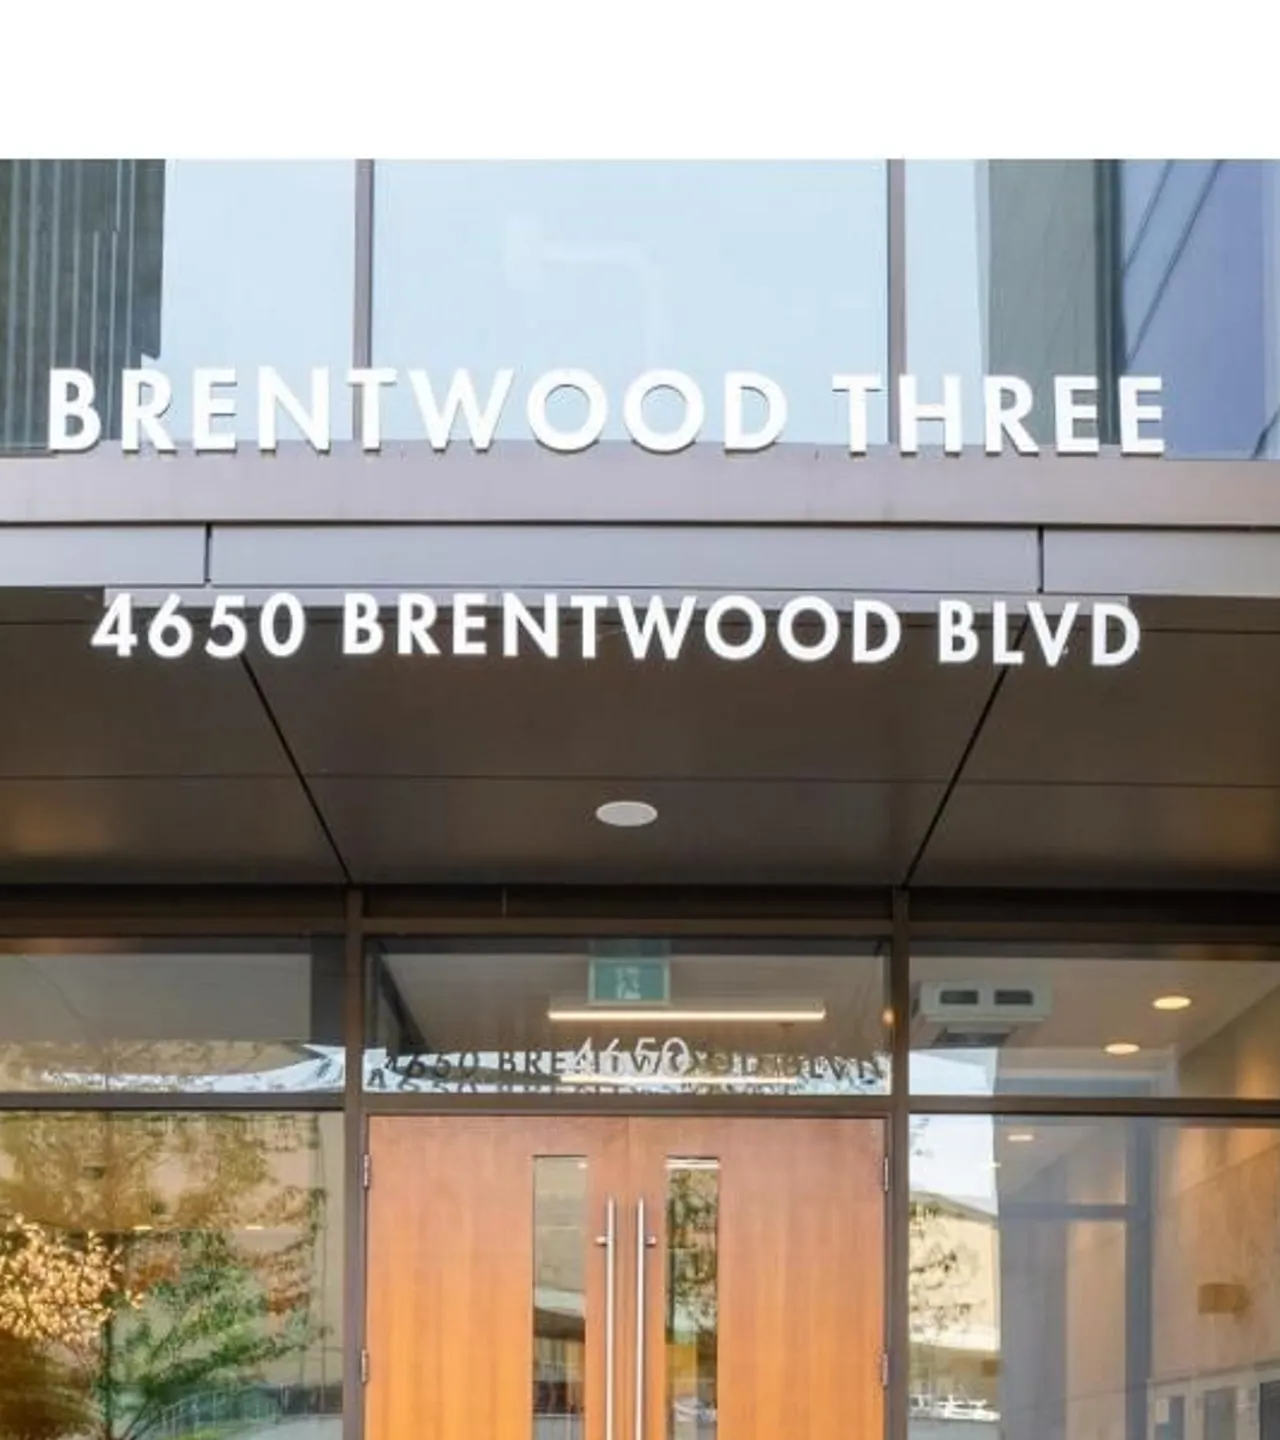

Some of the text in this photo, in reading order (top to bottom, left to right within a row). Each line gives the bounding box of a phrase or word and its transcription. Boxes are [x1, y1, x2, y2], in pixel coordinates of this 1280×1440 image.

[47, 366, 1166, 456] BRENTWOOD THREE
[90, 592, 1141, 667] 4650 BRENTWOOD BLVD
[573, 1037, 690, 1077] 4650
